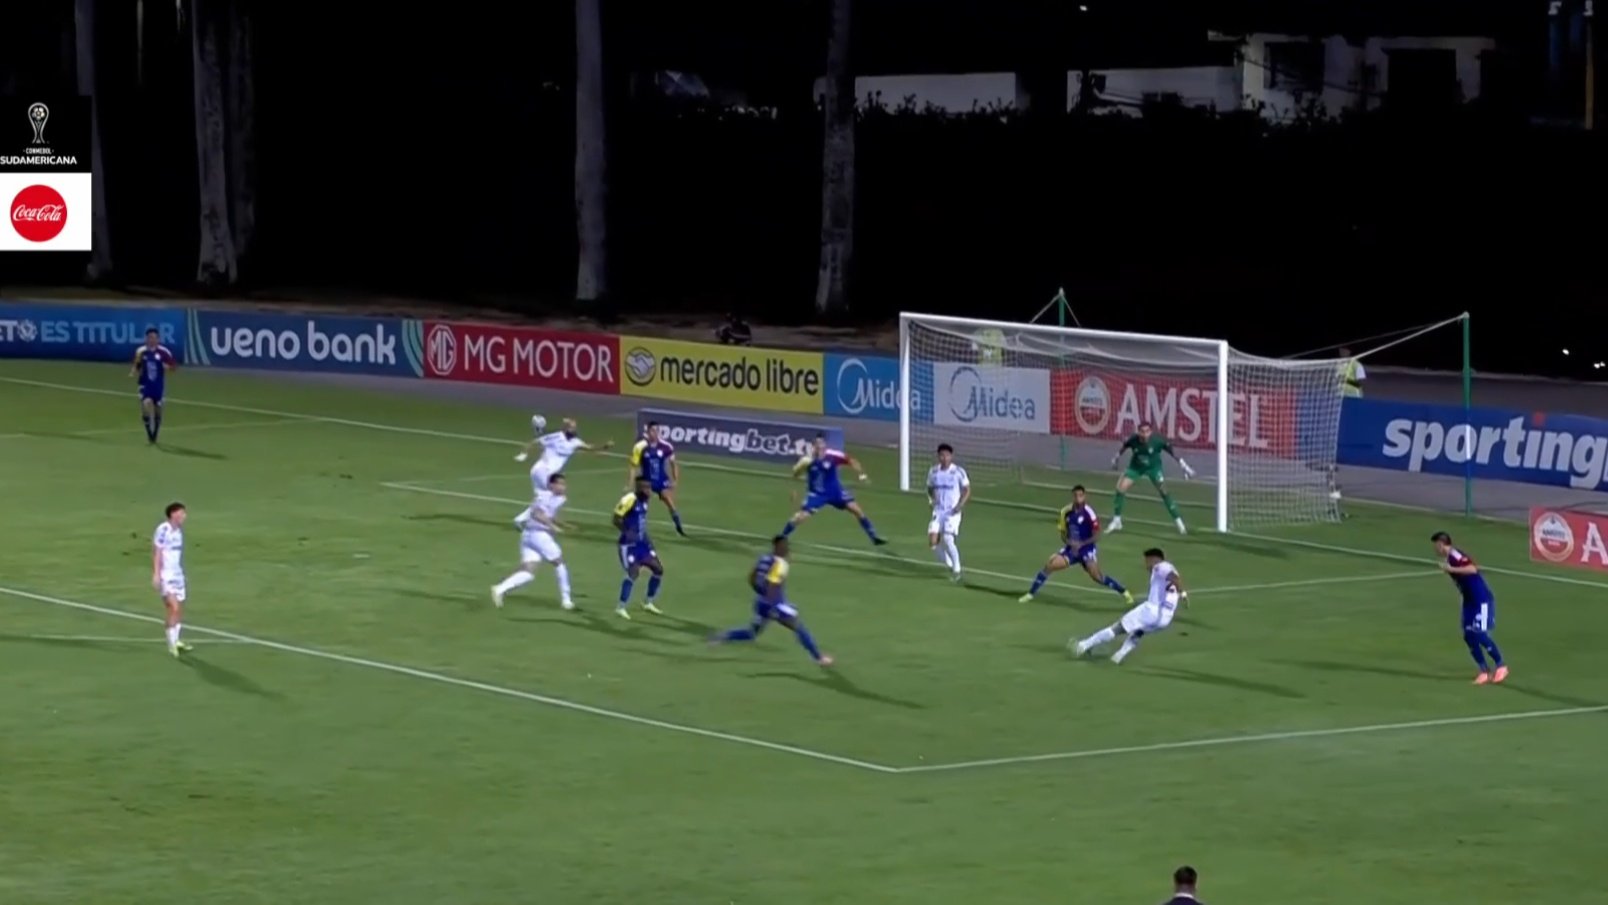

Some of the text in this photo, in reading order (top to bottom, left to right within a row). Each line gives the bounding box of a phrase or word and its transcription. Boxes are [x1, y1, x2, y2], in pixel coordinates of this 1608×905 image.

[0, 320, 175, 343] T ES TITULR
[211, 320, 396, 365] ueno bank
[464, 334, 614, 383] MG MOTOR
[660, 356, 819, 395] mercado libre
[963, 385, 1036, 420] Midea
[1114, 383, 1269, 448] AMSTEL
[643, 424, 814, 456] portingbet.t
[1382, 412, 1608, 489] sporting
